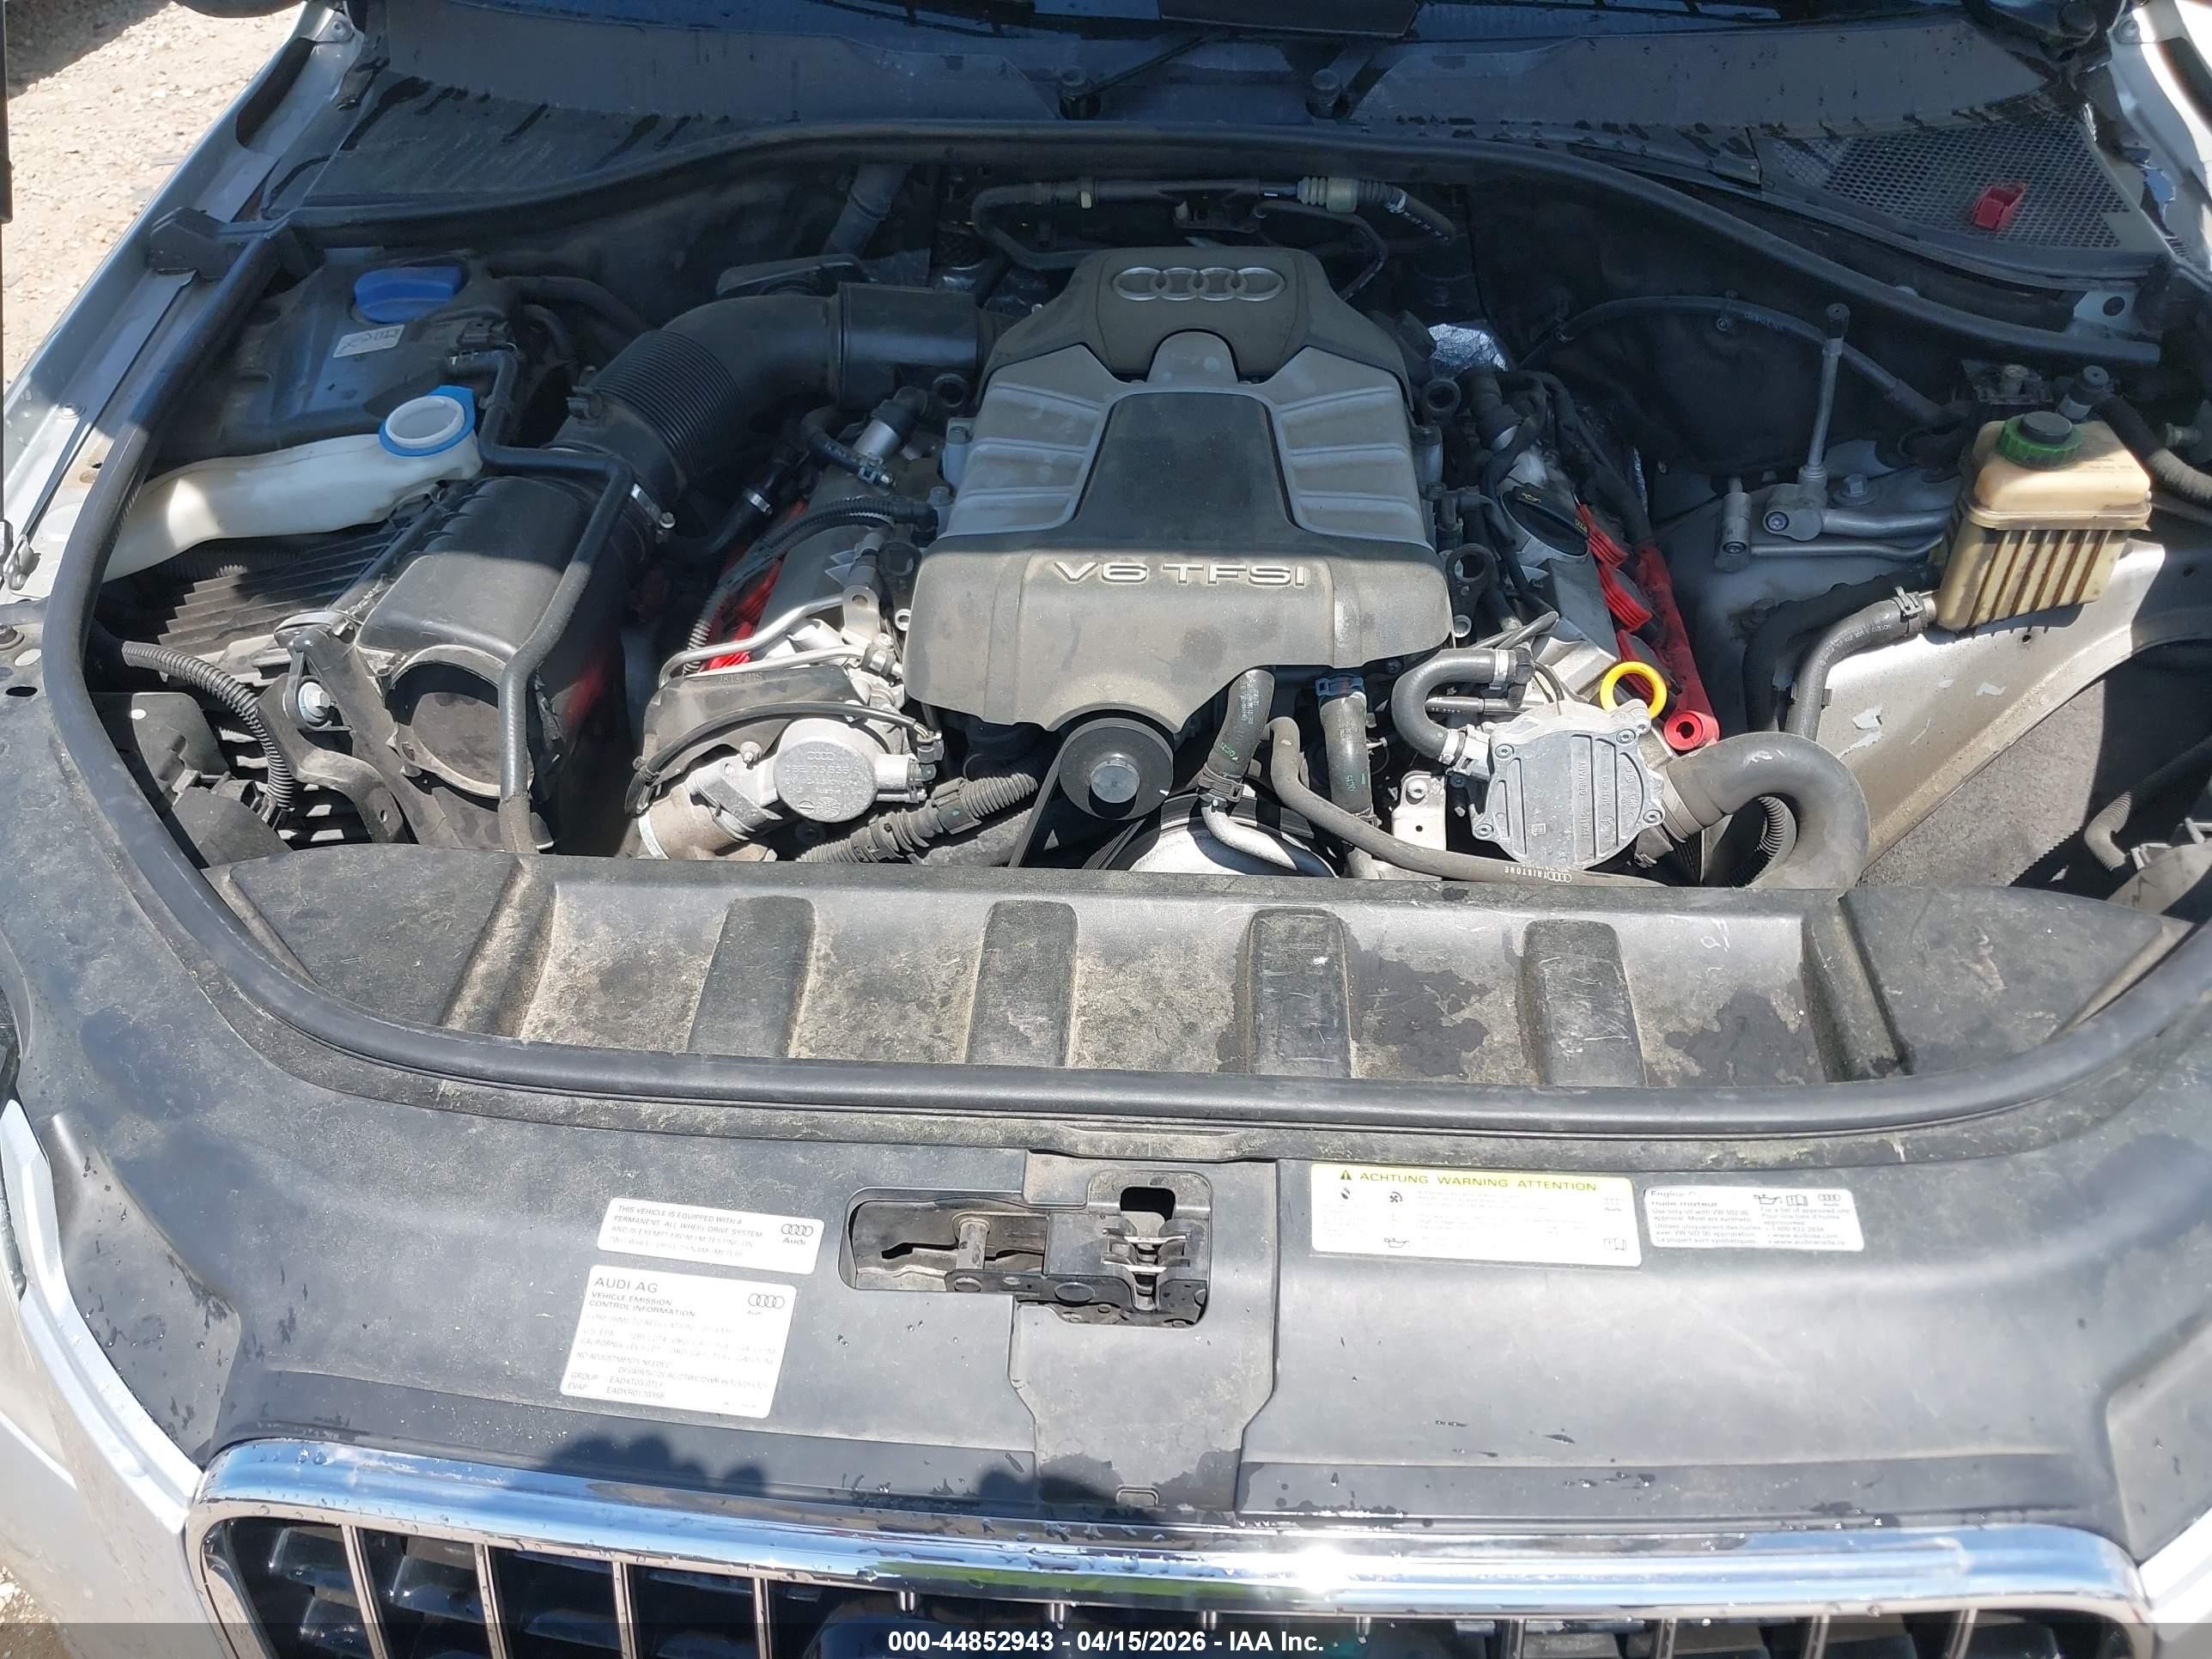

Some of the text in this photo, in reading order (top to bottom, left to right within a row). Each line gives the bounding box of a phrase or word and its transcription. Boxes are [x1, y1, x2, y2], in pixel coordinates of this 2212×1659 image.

[1055, 561, 1306, 587] V6 TFSI
[1504, 866, 1547, 880] TRISTONE
[1360, 1172, 1598, 1192] ACHTUNG WARNING ATTENTION
[636, 1207, 666, 1218] VEHICLE
[677, 1212, 714, 1223] EQUIPPED
[716, 1216, 735, 1224] WITH
[614, 1215, 763, 1238] PERMANENT ALL WHEEL DRIVE SYSTEM
[782, 1237, 806, 1246] Audi
[593, 1277, 659, 1293] AUDI AG
[592, 1291, 673, 1307] VEHICLE EMISSION
[589, 1300, 696, 1317] CONTROL INFORMATION
